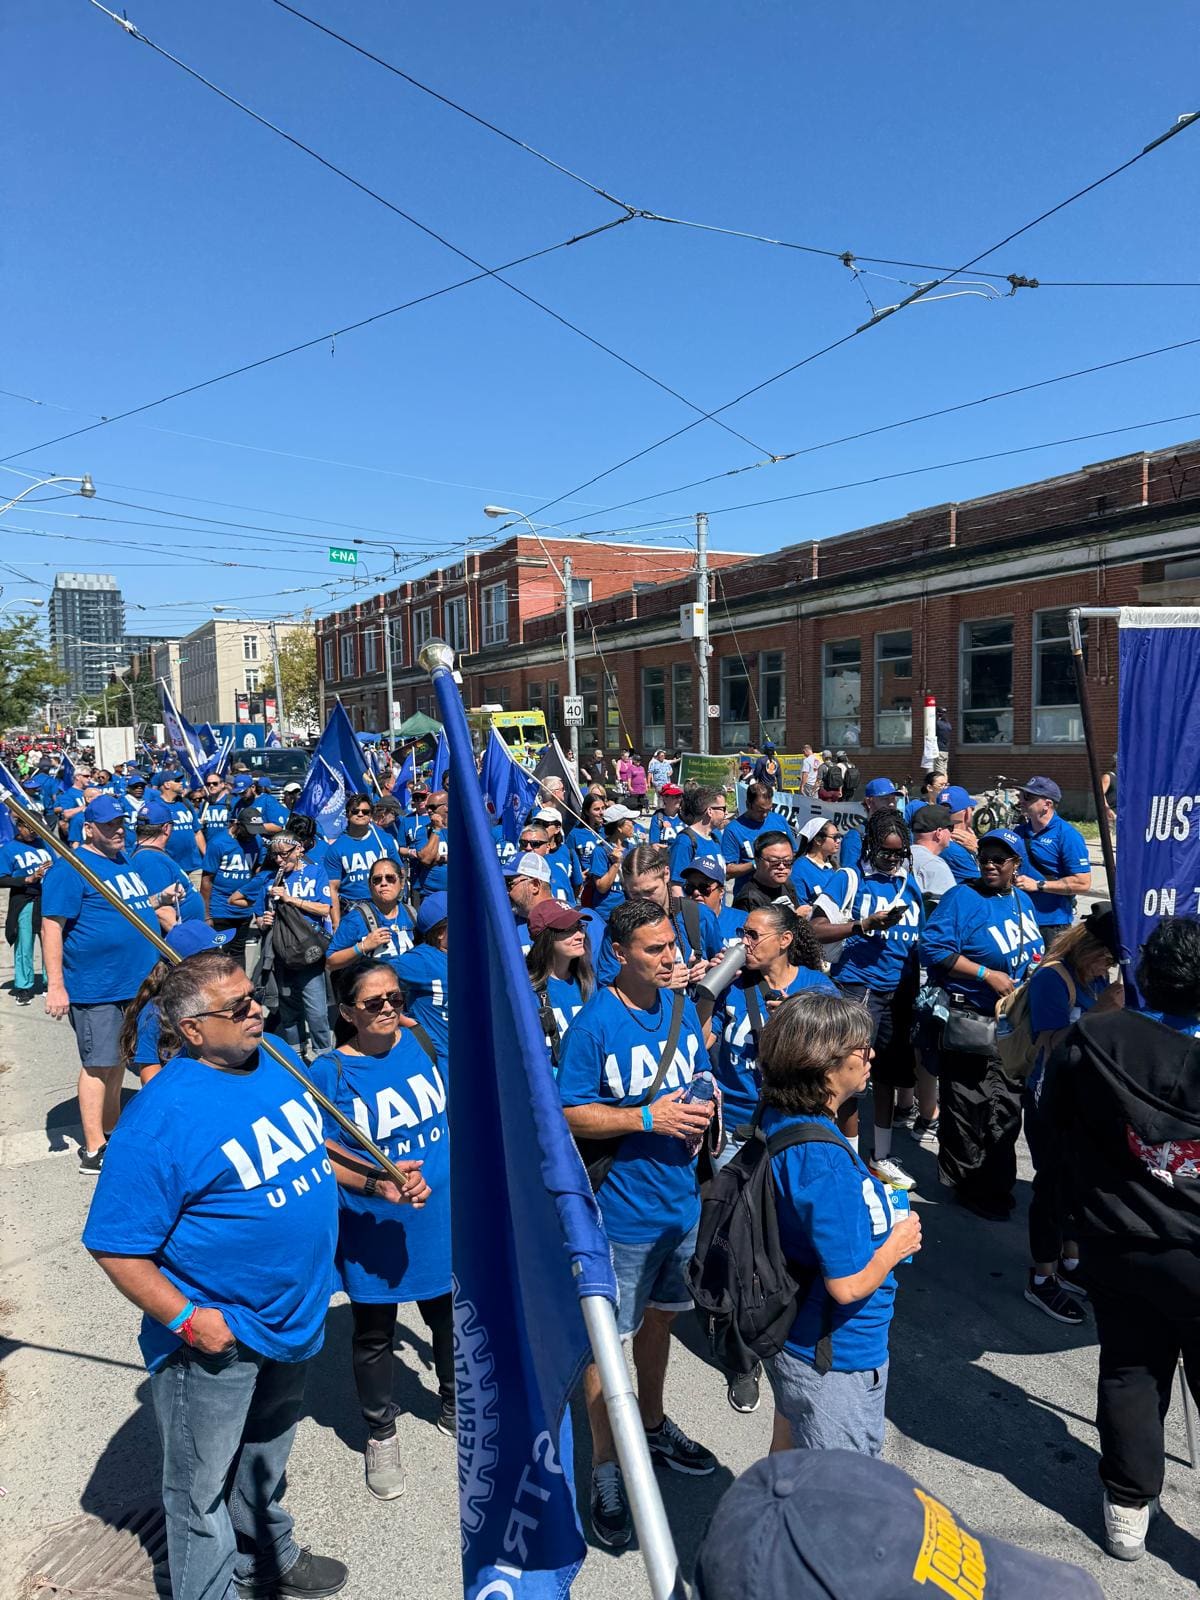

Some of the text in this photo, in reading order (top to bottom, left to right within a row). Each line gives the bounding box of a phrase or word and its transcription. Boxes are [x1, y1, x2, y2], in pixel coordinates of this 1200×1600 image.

[340, 551, 356, 563] NA
[566, 705, 582, 716] 40
[203, 809, 228, 821] AM
[703, 860, 716, 869] IAM
[1143, 888, 1176, 917] ON
[988, 909, 1043, 955] IAM
[1011, 945, 1046, 967] UNIO
[605, 1033, 699, 1099] IAM
[352, 1065, 447, 1142] IAM
[220, 1091, 325, 1191] IAM
[381, 1126, 445, 1157] UNIO
[266, 1158, 333, 1208] UNIO
